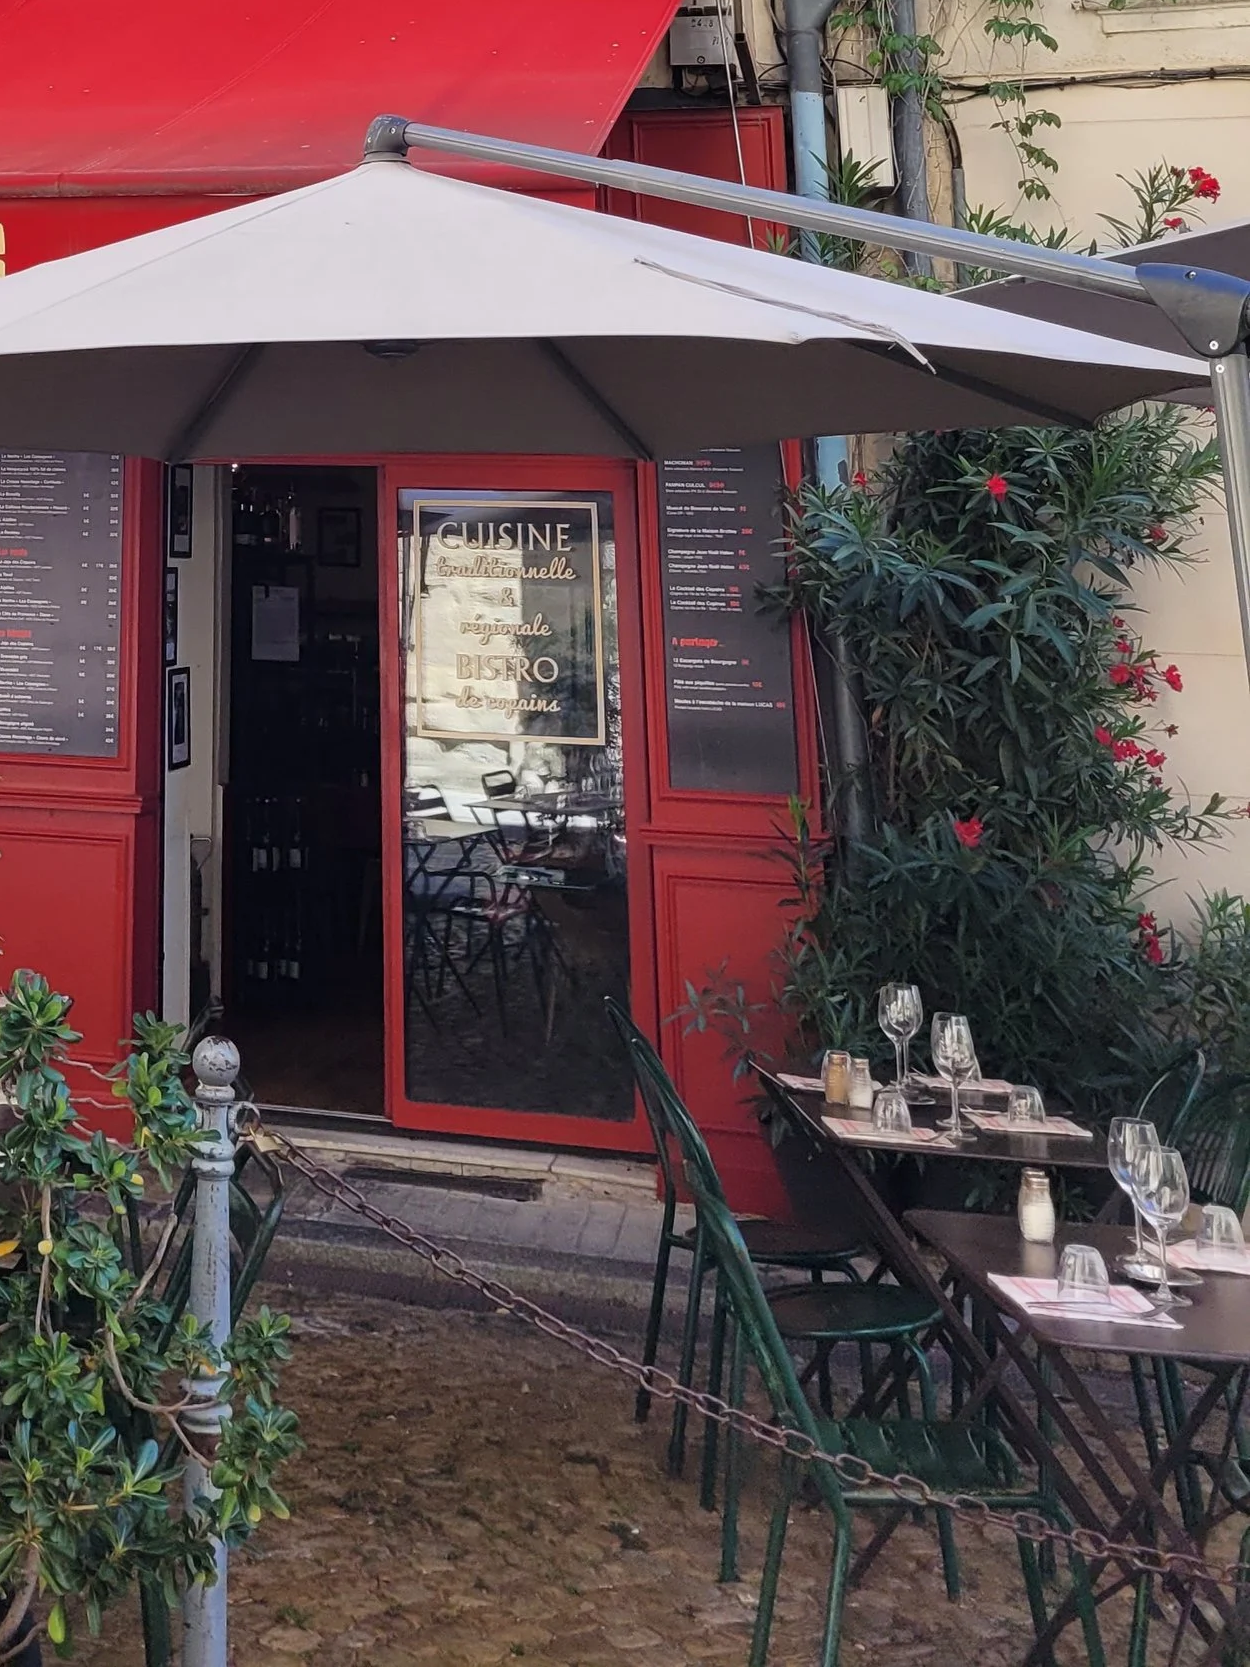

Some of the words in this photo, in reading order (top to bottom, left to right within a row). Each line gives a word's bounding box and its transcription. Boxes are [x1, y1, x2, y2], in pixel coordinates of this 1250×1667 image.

[437, 522, 572, 551] CUISINE
[436, 557, 575, 580] traditionnelle
[499, 587, 515, 607] &
[459, 613, 552, 645] régionale
[456, 654, 559, 683] BISTRO
[455, 686, 482, 709] de
[486, 693, 561, 718] copains
